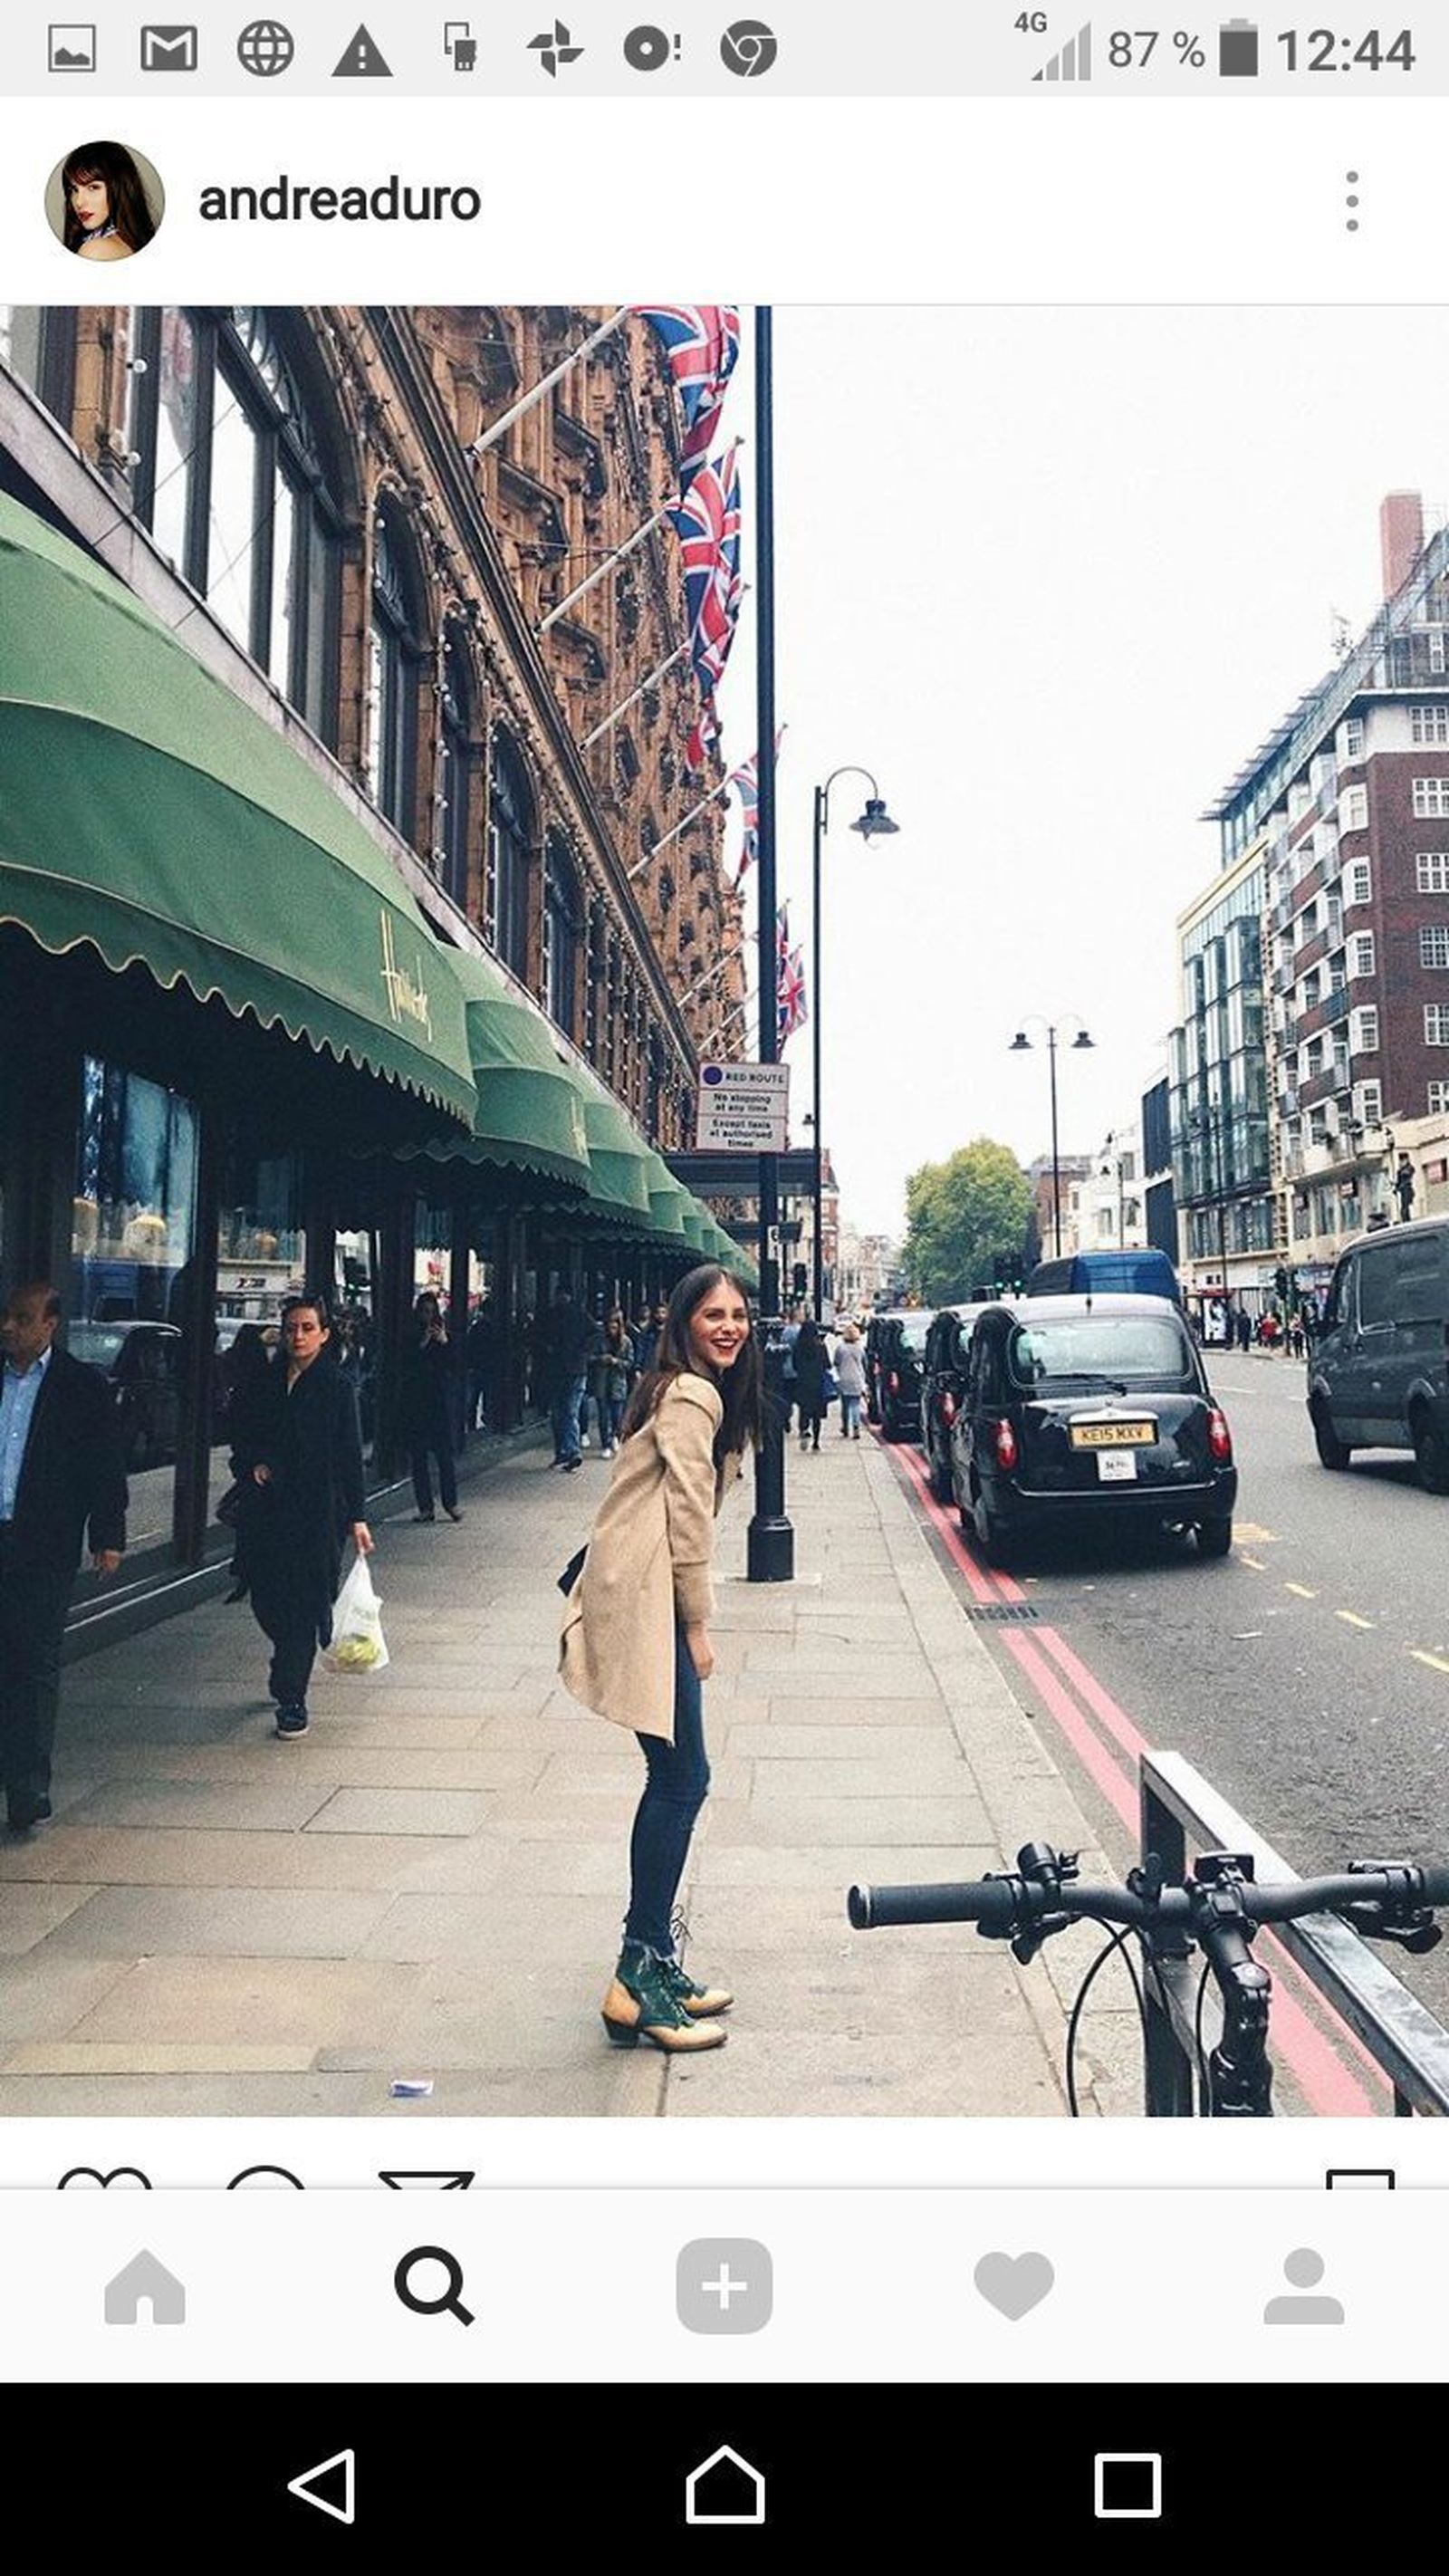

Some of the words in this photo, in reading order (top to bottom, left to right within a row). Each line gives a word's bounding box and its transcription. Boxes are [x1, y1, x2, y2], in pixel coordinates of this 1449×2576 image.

[725, 1072, 747, 1081] RED
[750, 1073, 784, 1083] ROUTE
[714, 1093, 728, 1101] No
[731, 1094, 772, 1104] stopping
[715, 1103, 725, 1111] at
[728, 1104, 744, 1112] any
[1081, 1427, 1113, 1442] KE15
